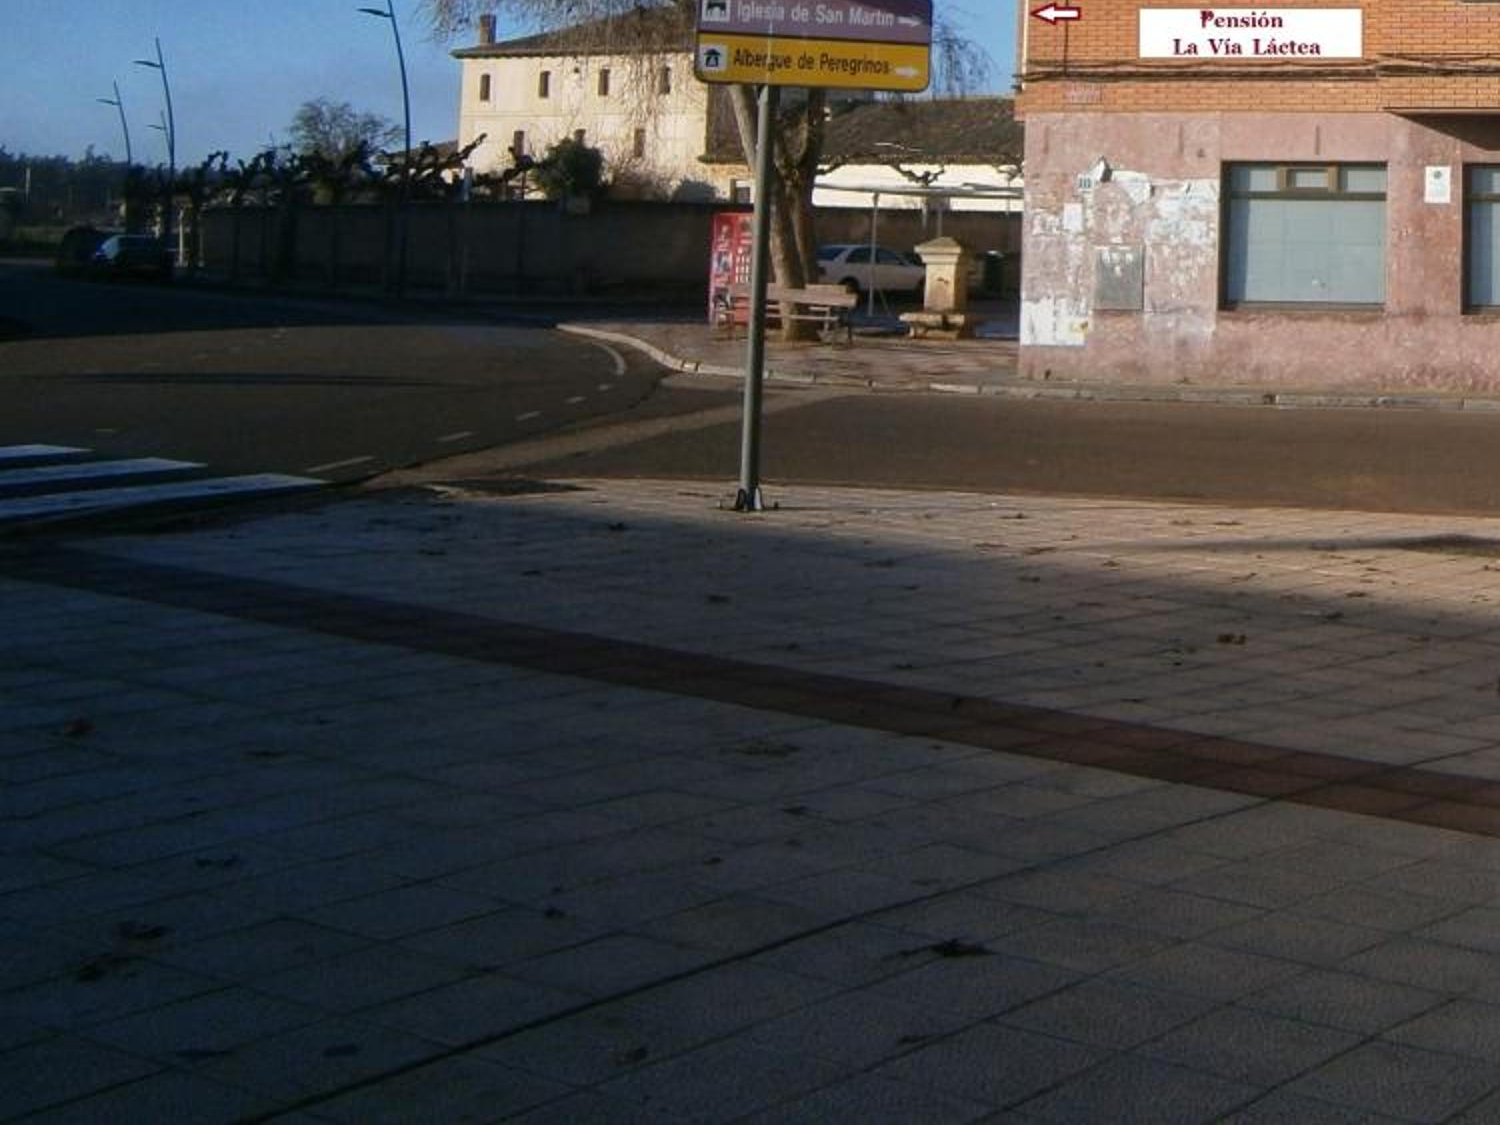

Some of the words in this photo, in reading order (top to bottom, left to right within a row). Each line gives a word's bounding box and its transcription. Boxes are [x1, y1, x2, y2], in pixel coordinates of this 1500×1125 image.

[737, 0, 785, 22] Iglesia
[791, 5, 810, 22] de
[815, 3, 843, 24] San
[1200, 10, 1283, 29] Pensión
[1173, 38, 1198, 56] La
[1209, 37, 1242, 56] Vía
[1253, 37, 1321, 56] Láctea
[734, 47, 792, 72] Albergue
[797, 51, 815, 69] de
[820, 52, 889, 76] Peregrinos
